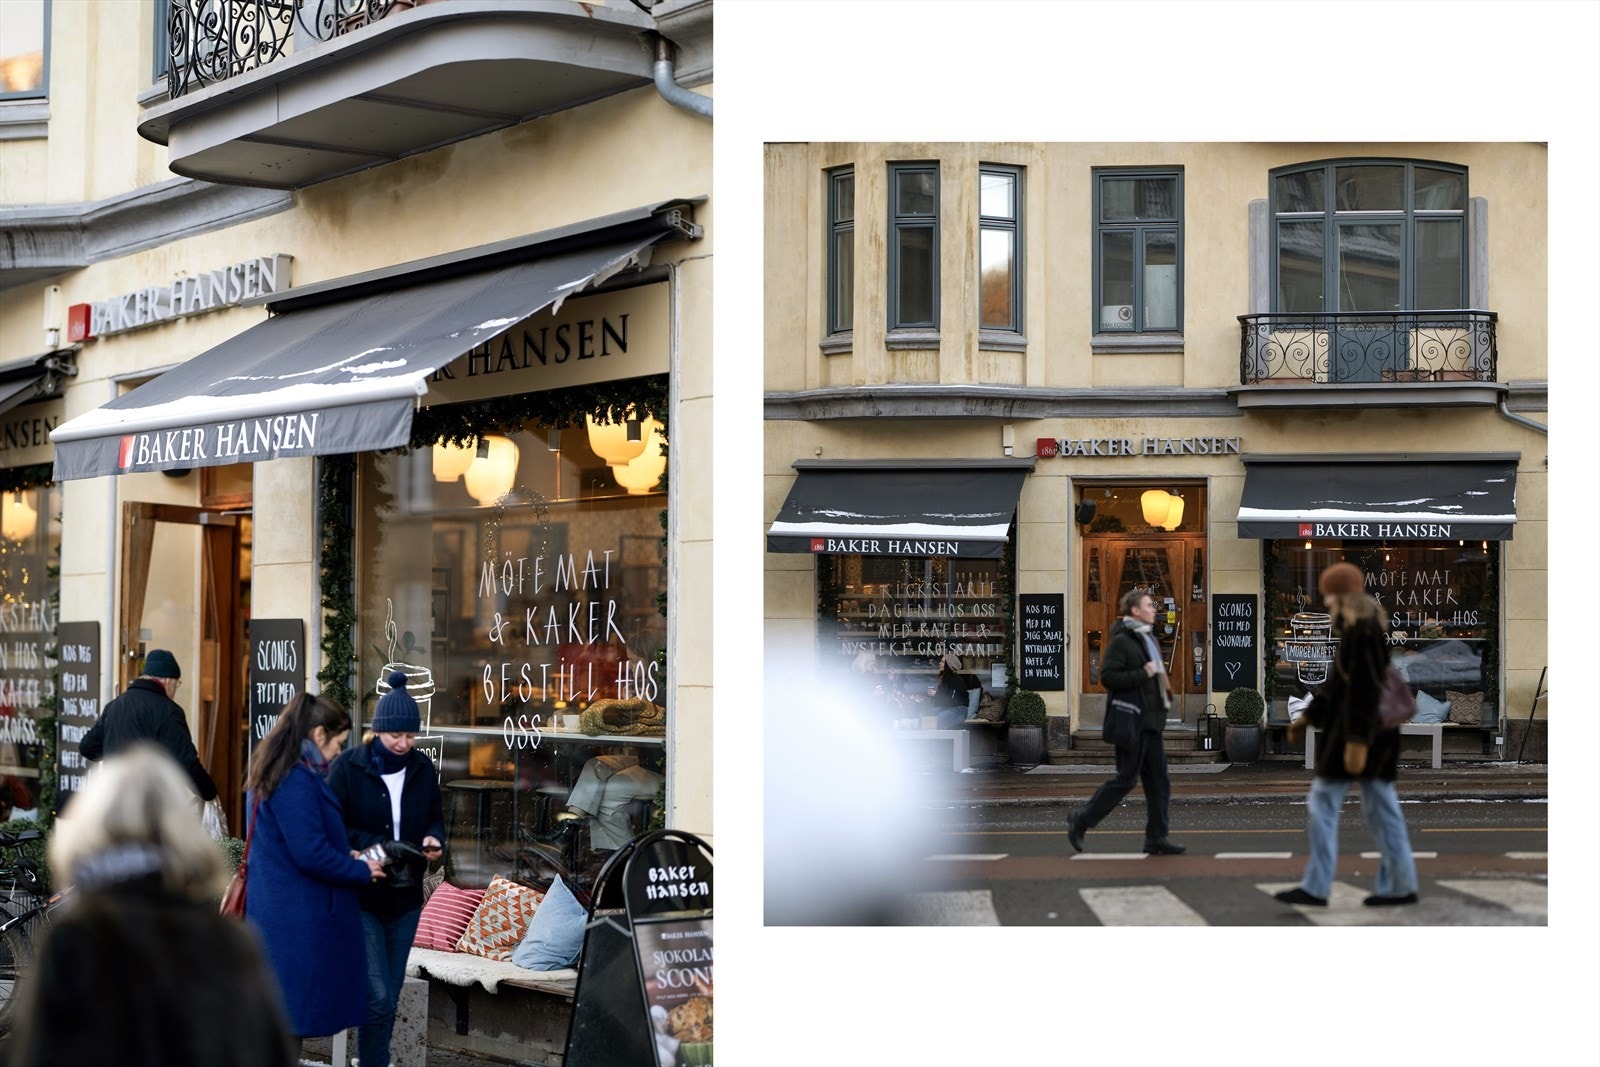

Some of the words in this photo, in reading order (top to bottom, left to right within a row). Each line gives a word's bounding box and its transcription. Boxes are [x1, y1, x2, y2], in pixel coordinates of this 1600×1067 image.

[89, 286, 161, 337] BAKER
[168, 255, 284, 315] HANSEN
[467, 313, 630, 378] HANSEN
[0, 415, 59, 450] NSEN
[136, 428, 206, 465] BAKER
[215, 413, 319, 458] HANSEN
[1041, 447, 1057, 456] 1861
[1060, 438, 1137, 456] BAKER
[1142, 436, 1241, 456] HANSEN
[1315, 523, 1372, 537] BAKER
[1378, 524, 1452, 538] HANSEN
[827, 539, 882, 553] BAKER
[888, 540, 959, 555] HANSEN
[555, 549, 615, 593] MAT
[1415, 569, 1451, 586] MAT
[882, 581, 999, 600] KICKSTARTE
[1396, 588, 1459, 606] KAKER
[869, 603, 927, 619] DAGEN
[938, 603, 965, 618] HOS
[973, 603, 996, 618] OSS
[1025, 604, 1040, 614] KOS
[1218, 602, 1252, 618] SCONES
[1452, 610, 1479, 626] HOS
[489, 612, 510, 646] &
[526, 599, 626, 646] KAKER
[878, 624, 911, 639] MED
[976, 623, 991, 640] &
[1040, 619, 1051, 629] EN
[1236, 620, 1251, 632] MED
[257, 640, 297, 672] SCONES
[615, 659, 660, 702] HOS
